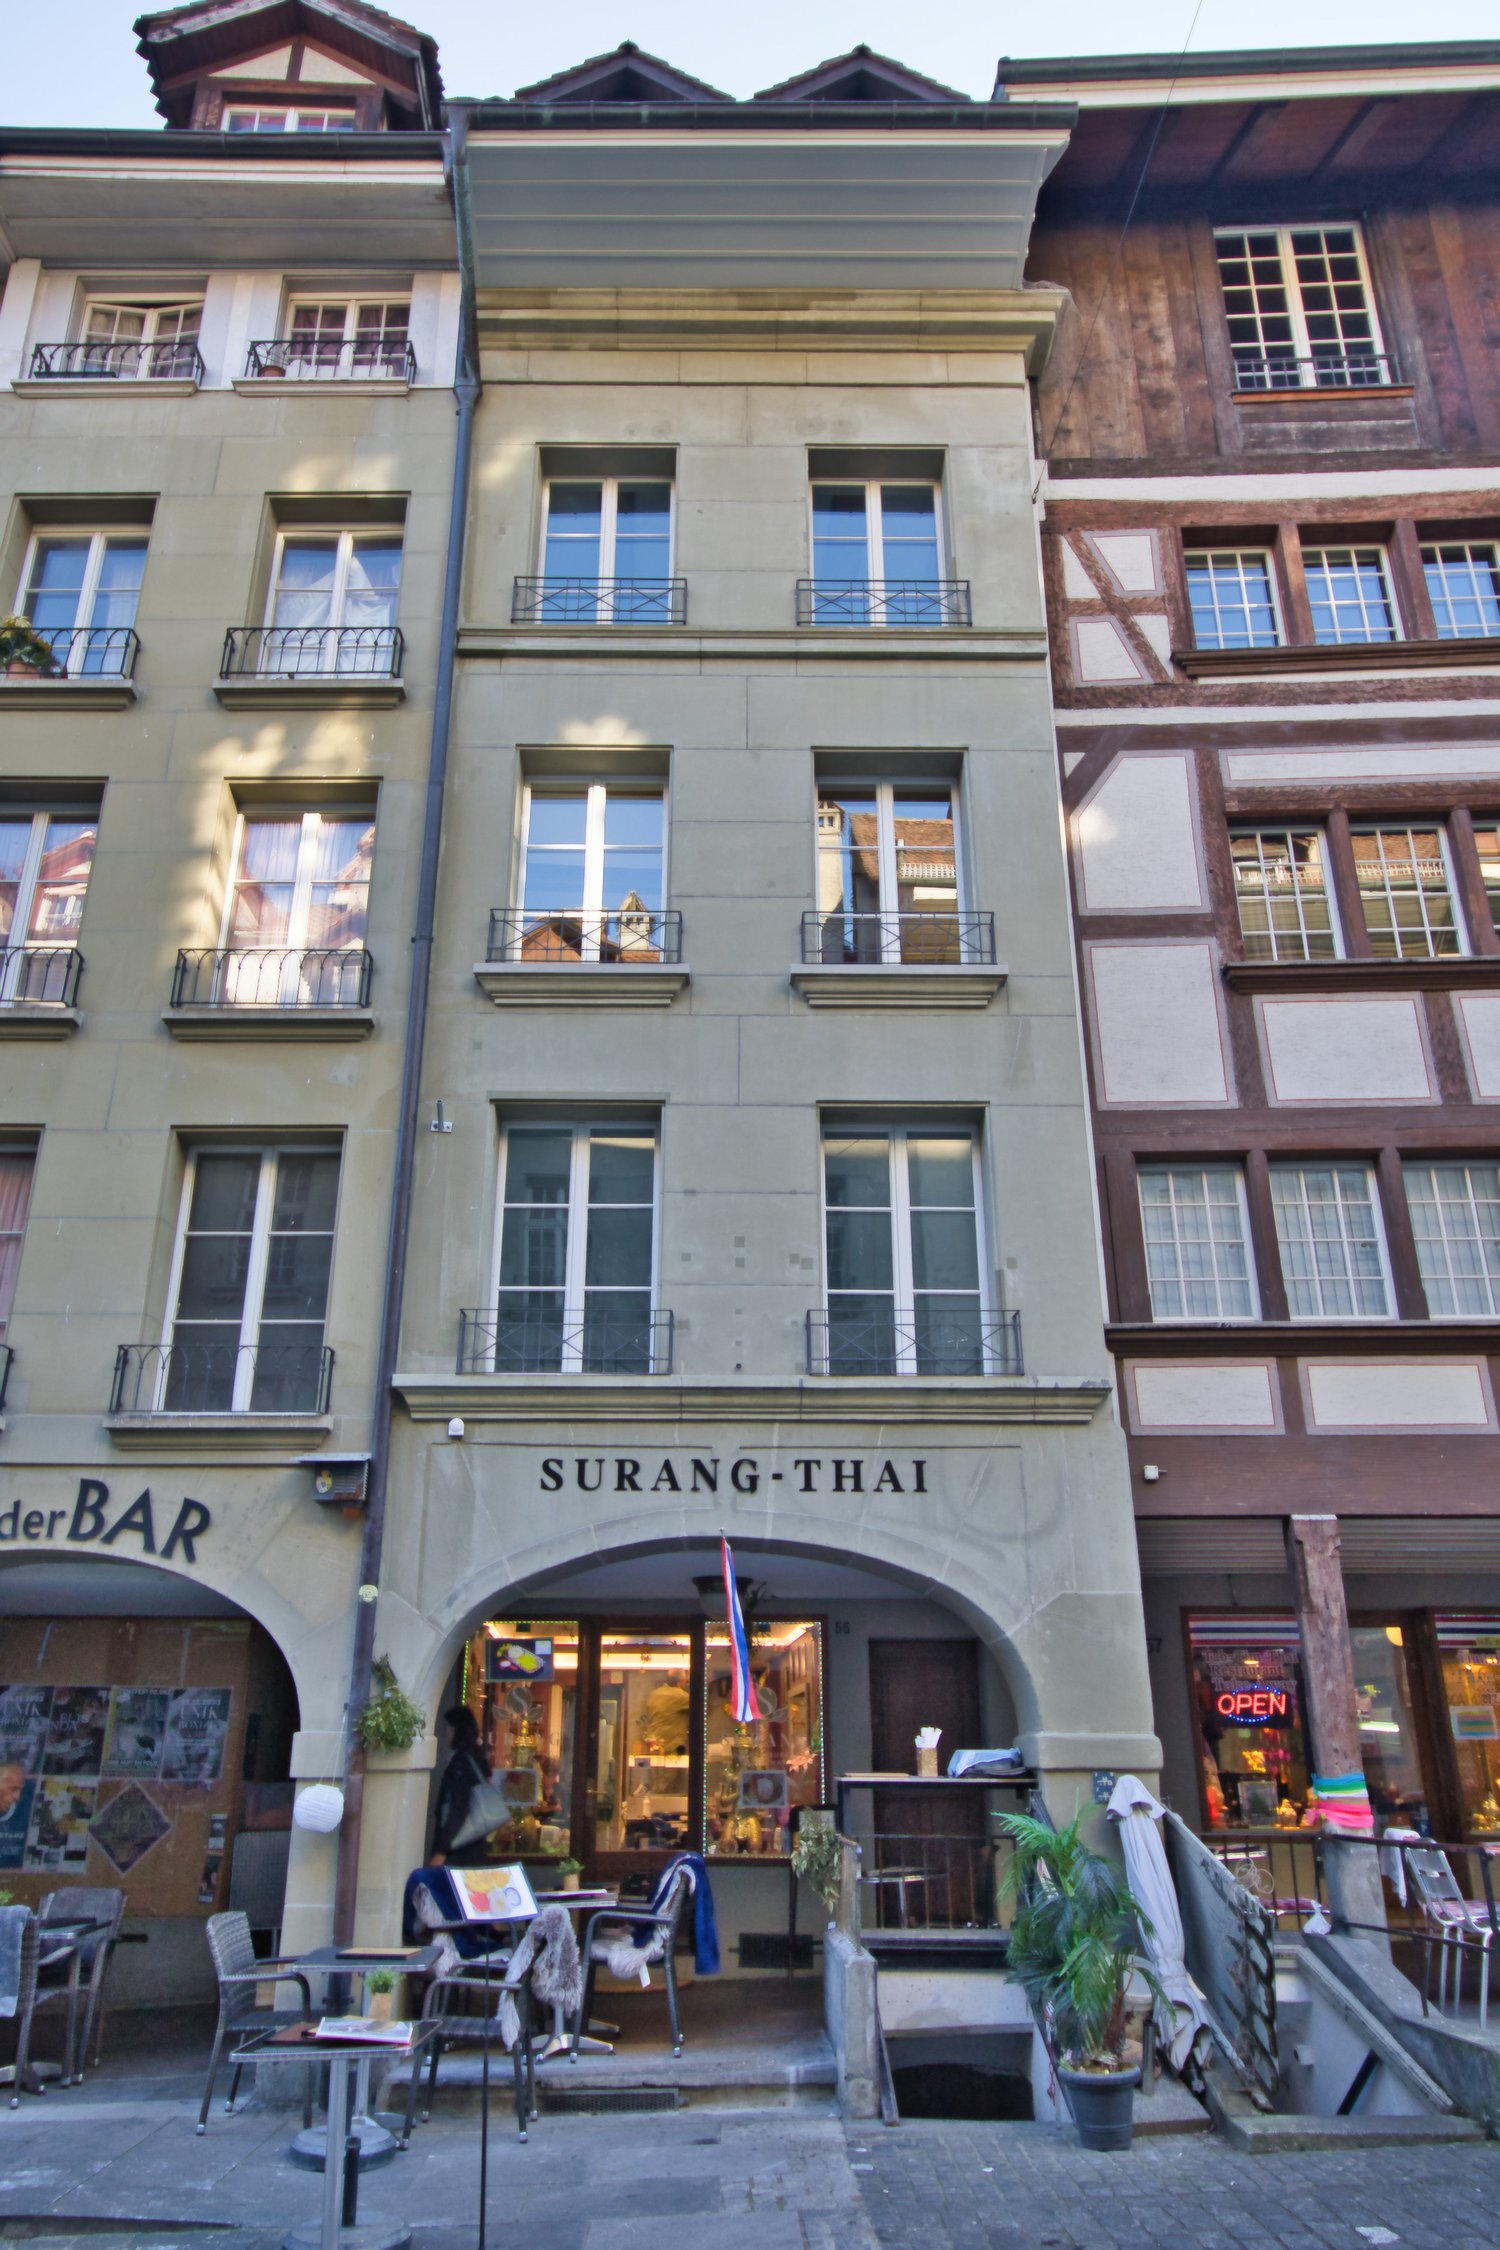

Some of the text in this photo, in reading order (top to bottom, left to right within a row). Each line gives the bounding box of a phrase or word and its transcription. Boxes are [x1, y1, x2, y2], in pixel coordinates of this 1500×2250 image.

[540, 1458, 928, 1494] SURANG-THAI
[1210, 1665, 1285, 1678] Restaurant
[1217, 1693, 1286, 1715] OPEN
